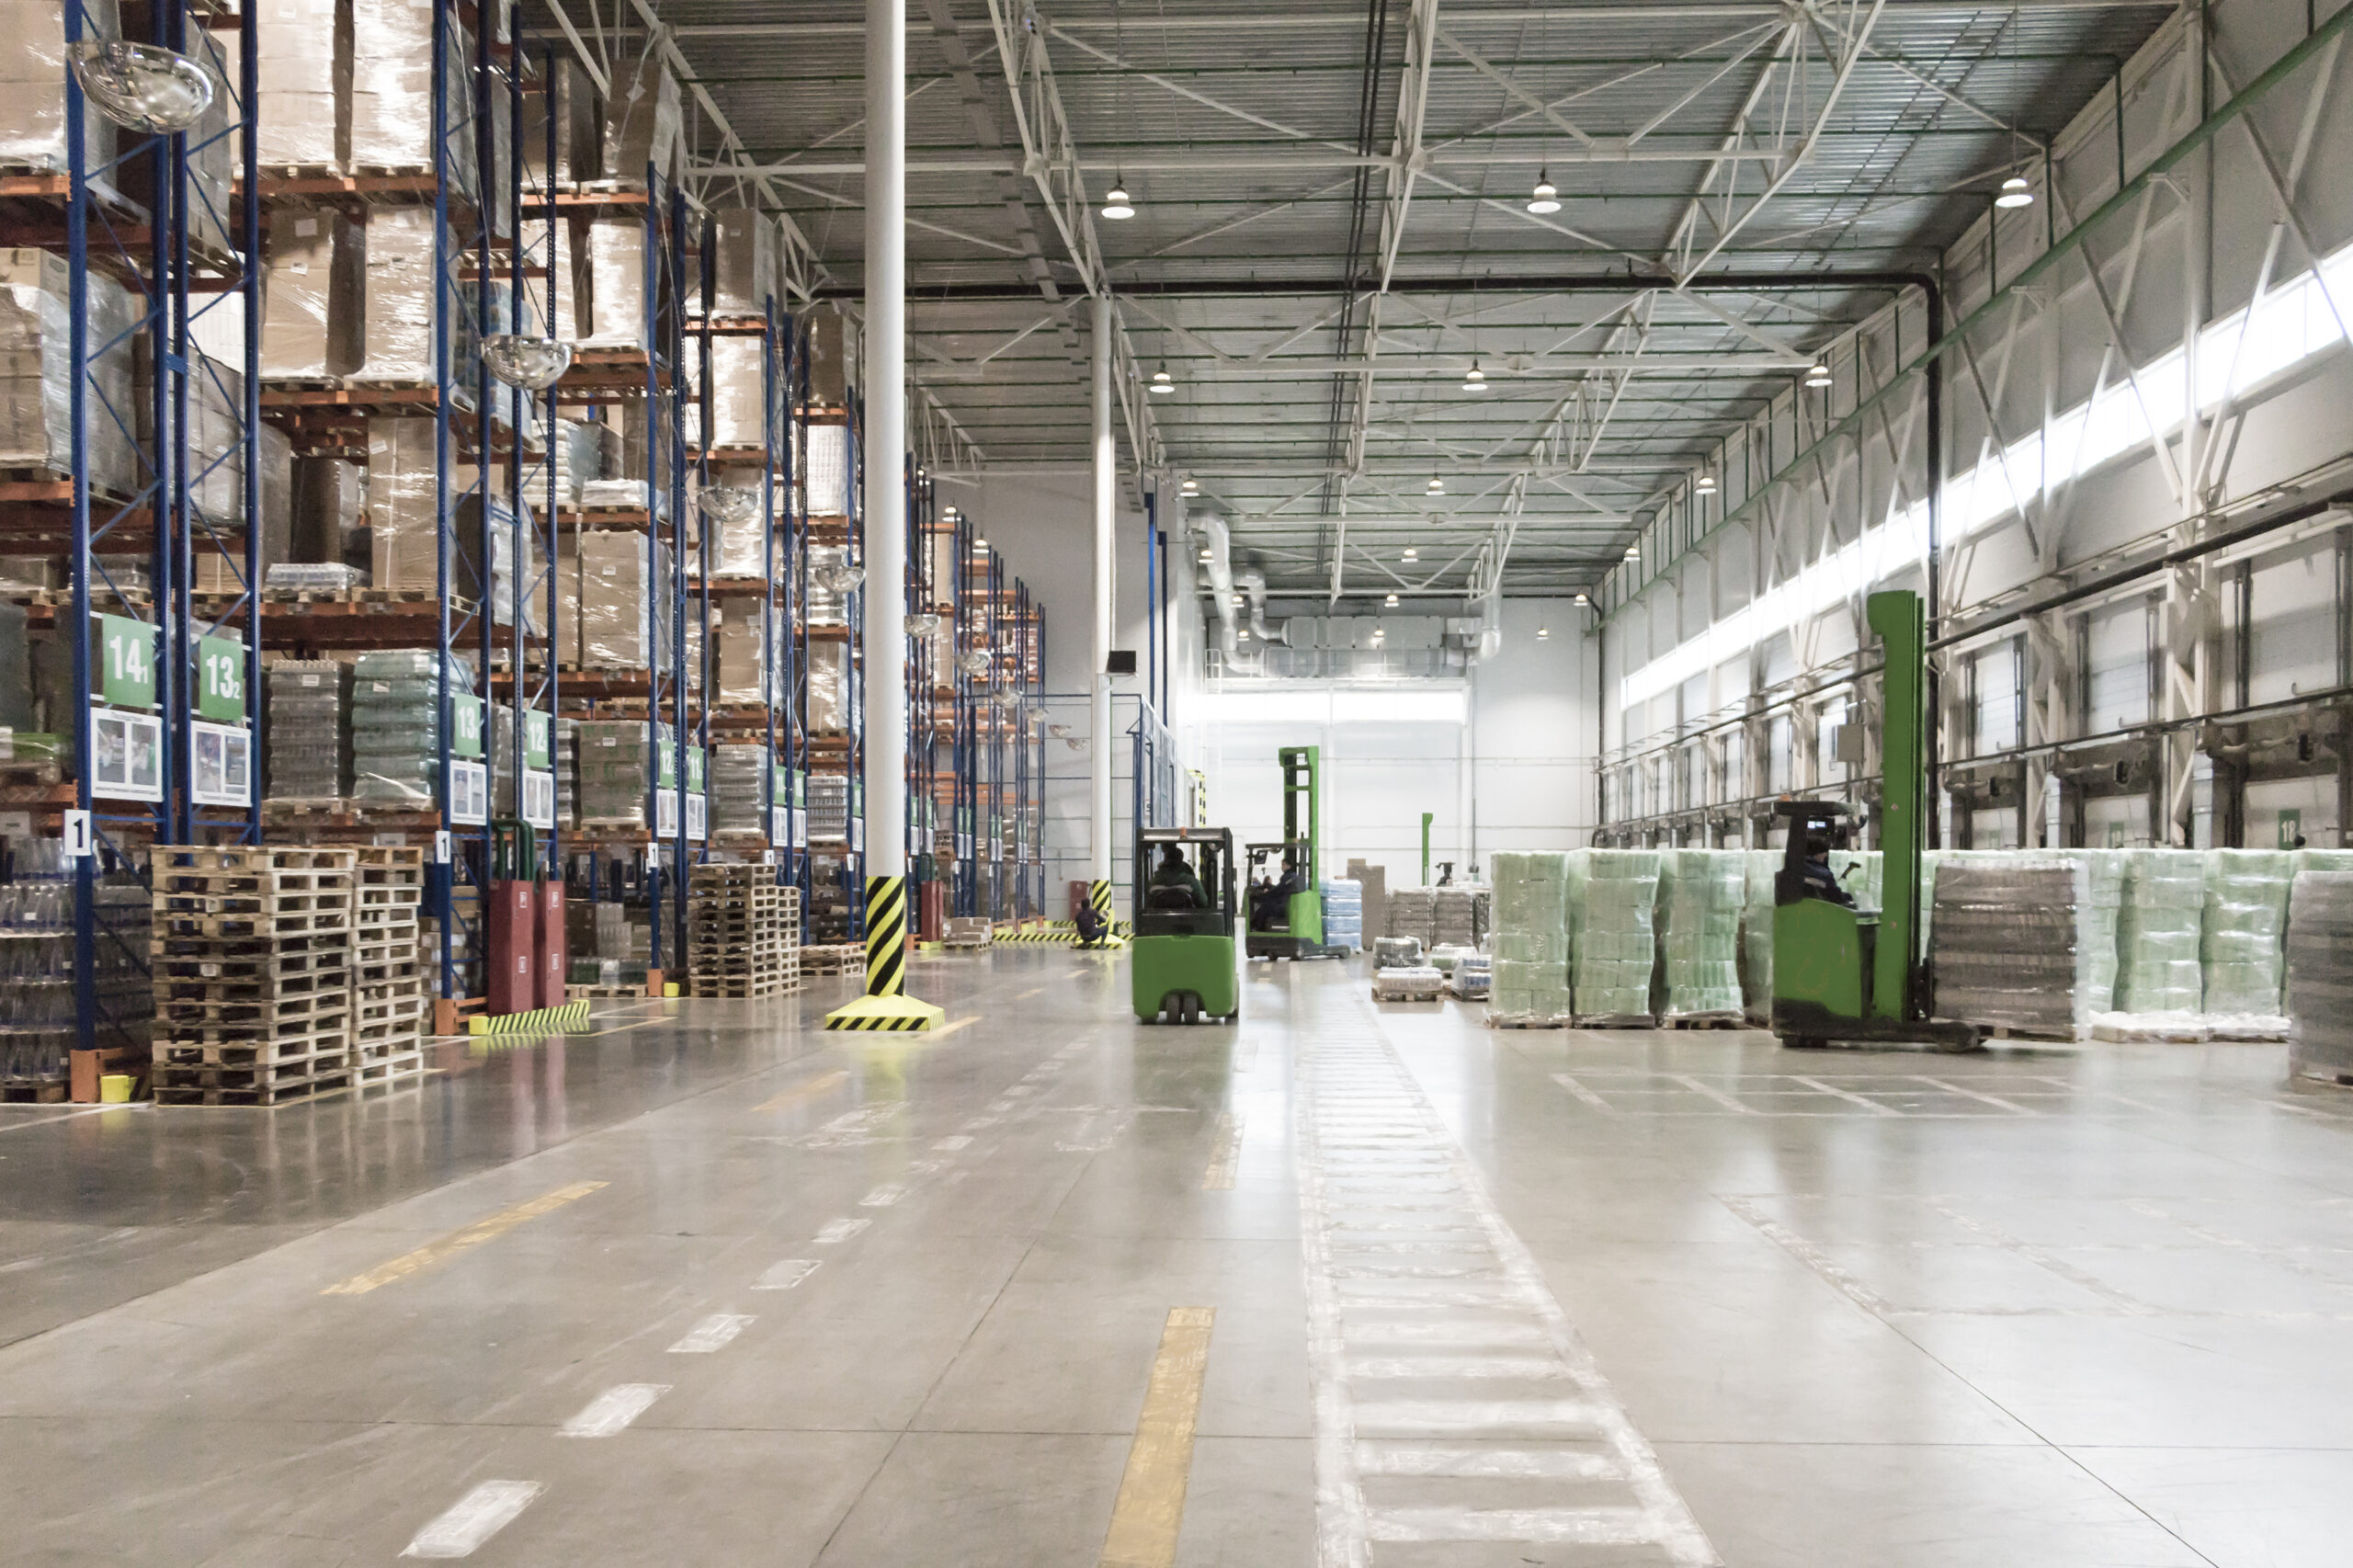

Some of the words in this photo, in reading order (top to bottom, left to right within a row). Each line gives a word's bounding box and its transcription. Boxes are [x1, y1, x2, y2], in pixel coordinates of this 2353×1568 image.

[74, 818, 83, 848] 1
[2281, 820, 2296, 843] 18
[441, 837, 447, 858] 1
[652, 847, 656, 863] 1
